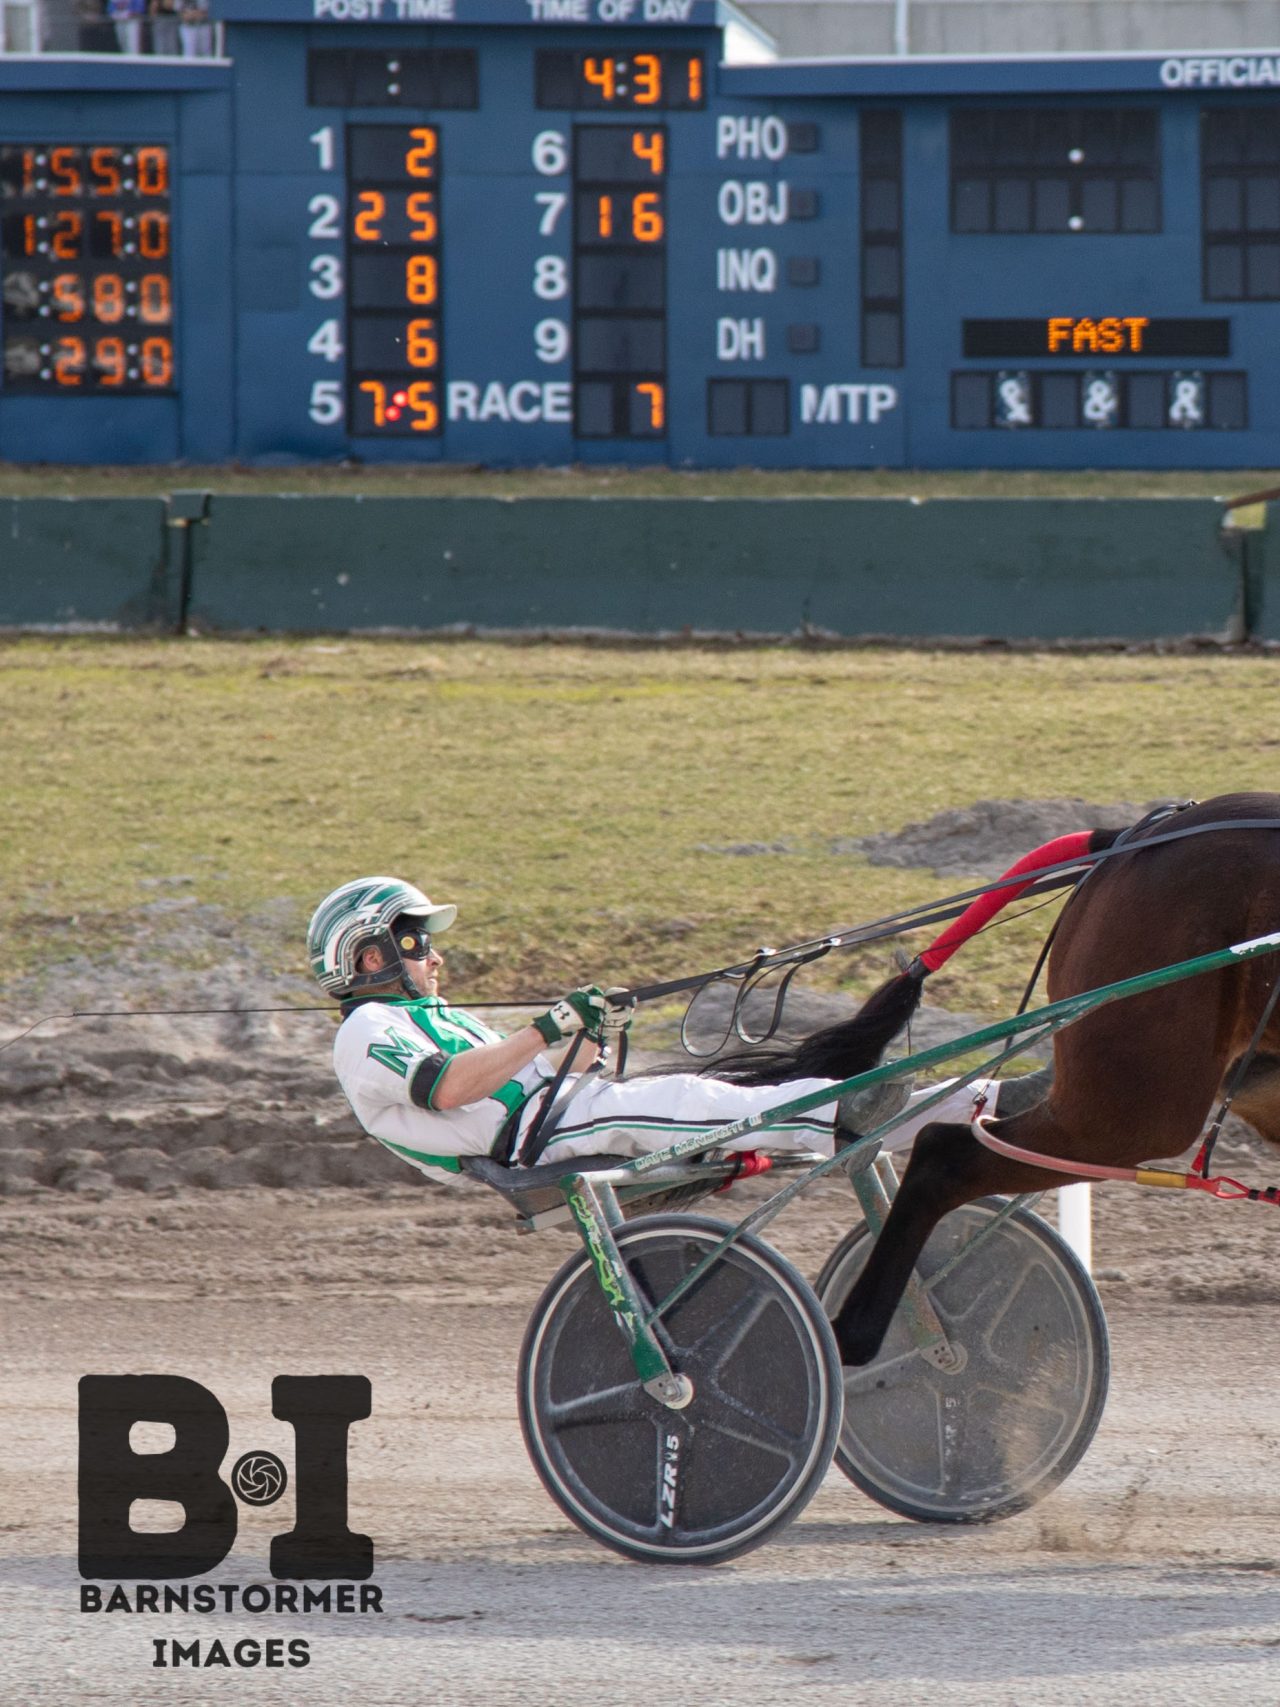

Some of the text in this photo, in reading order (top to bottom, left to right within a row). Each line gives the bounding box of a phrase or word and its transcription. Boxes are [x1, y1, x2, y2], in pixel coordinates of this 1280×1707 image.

[314, 0, 453, 20] POST TIME
[529, 0, 692, 21] TIME OF DAY
[311, 128, 333, 170] 1
[406, 128, 436, 177] 2
[533, 131, 567, 175] 6
[632, 133, 663, 173] 4
[718, 116, 787, 160] PHO
[309, 195, 340, 238] 2
[536, 193, 566, 235] 7
[719, 181, 788, 225] OBJ
[310, 255, 343, 299] 3
[406, 255, 437, 304] 8
[534, 255, 568, 300] 8
[718, 248, 776, 292] INQ
[309, 320, 343, 361] 4
[407, 319, 437, 367] 6
[535, 319, 569, 363] 9
[718, 318, 764, 360] DH
[1048, 317, 1148, 352] FAST
[310, 381, 343, 424] 5
[448, 381, 571, 422] RACE
[637, 382, 663, 427] 7
[802, 384, 896, 423] MTP
[1084, 381, 1116, 421] &
